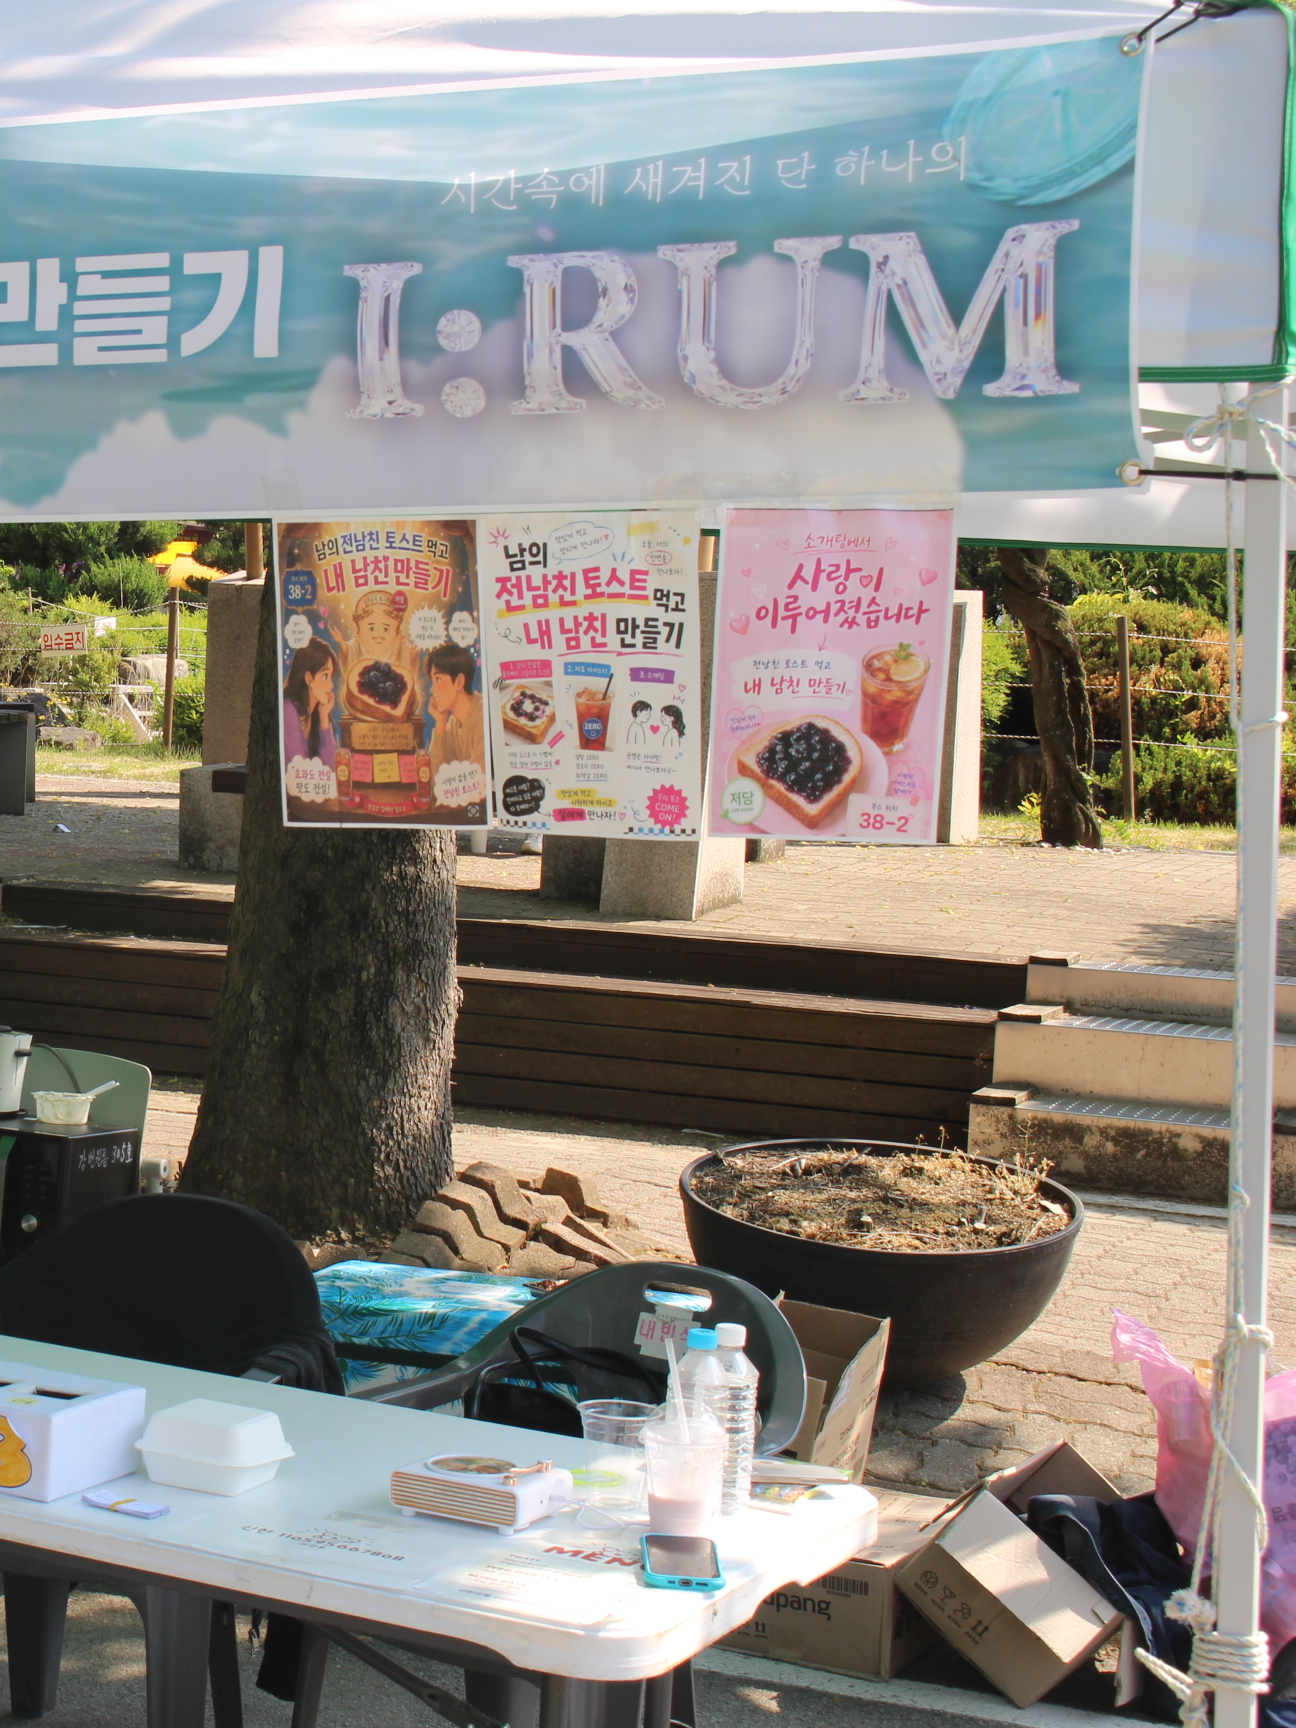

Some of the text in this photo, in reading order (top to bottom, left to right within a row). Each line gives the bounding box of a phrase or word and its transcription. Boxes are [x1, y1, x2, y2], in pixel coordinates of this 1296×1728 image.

[442, 135, 968, 213] 시간속에 새겨진 단 하나의
[342, 218, 1080, 420] I:RUM
[314, 531, 449, 562] 남의 전남친 토스트 먹고
[804, 532, 872, 549] 소개팅에서
[503, 542, 548, 571] 남의
[322, 556, 452, 598] 내 남친 만들기
[787, 557, 884, 595] 사랑이
[288, 584, 312, 599] 38-2
[495, 566, 686, 614] 전남친 토스트 먹고
[755, 594, 930, 634] 이루어졌습니다
[43, 631, 85, 651] 입수금지
[522, 612, 685, 651] 내 남친 만들기
[752, 658, 832, 670] 전남친 토스트 먹고
[744, 676, 846, 695] 내 남친 만들기
[584, 722, 602, 730] ZERO
[295, 769, 332, 780] 효과도 전설
[296, 782, 331, 794] 맛도 전설!
[729, 791, 754, 805] 저당
[586, 810, 617, 821] 만나자!
[655, 802, 680, 813] COME
[658, 812, 676, 821] ON!
[859, 812, 909, 833] 38-2
[542, 1545, 646, 1571] MEN
[762, 1591, 832, 1621] upang
